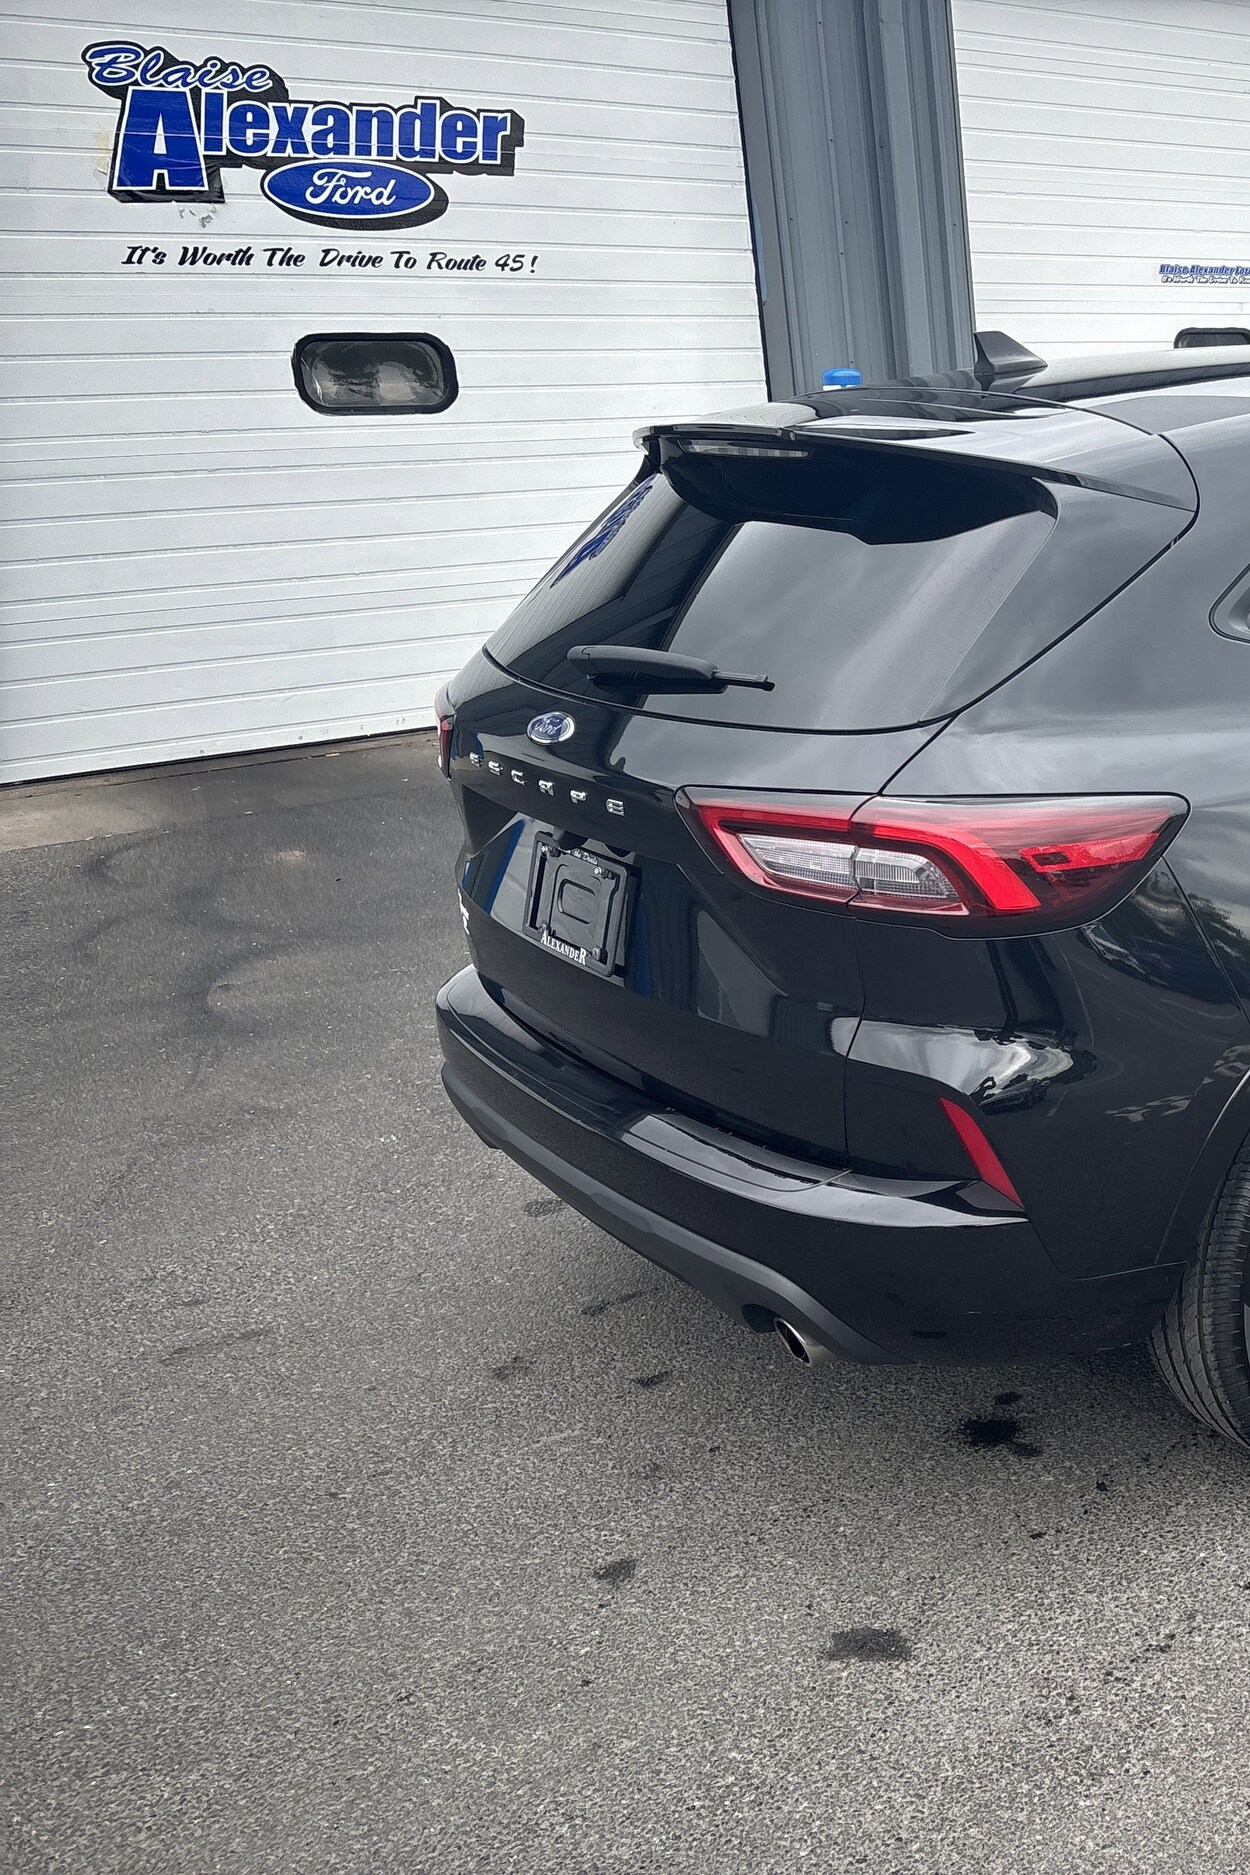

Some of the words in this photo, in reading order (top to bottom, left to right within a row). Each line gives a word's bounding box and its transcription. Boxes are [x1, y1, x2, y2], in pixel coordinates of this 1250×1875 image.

[85, 44, 273, 92] Blaise
[115, 86, 511, 192] Alexander
[304, 167, 396, 208] Ford
[121, 245, 167, 265] It's
[178, 246, 255, 266] Worth
[263, 247, 306, 267] The
[319, 248, 383, 268] Drive
[390, 250, 417, 270] To
[427, 251, 487, 271] Route
[469, 751, 625, 817] ESCAPE
